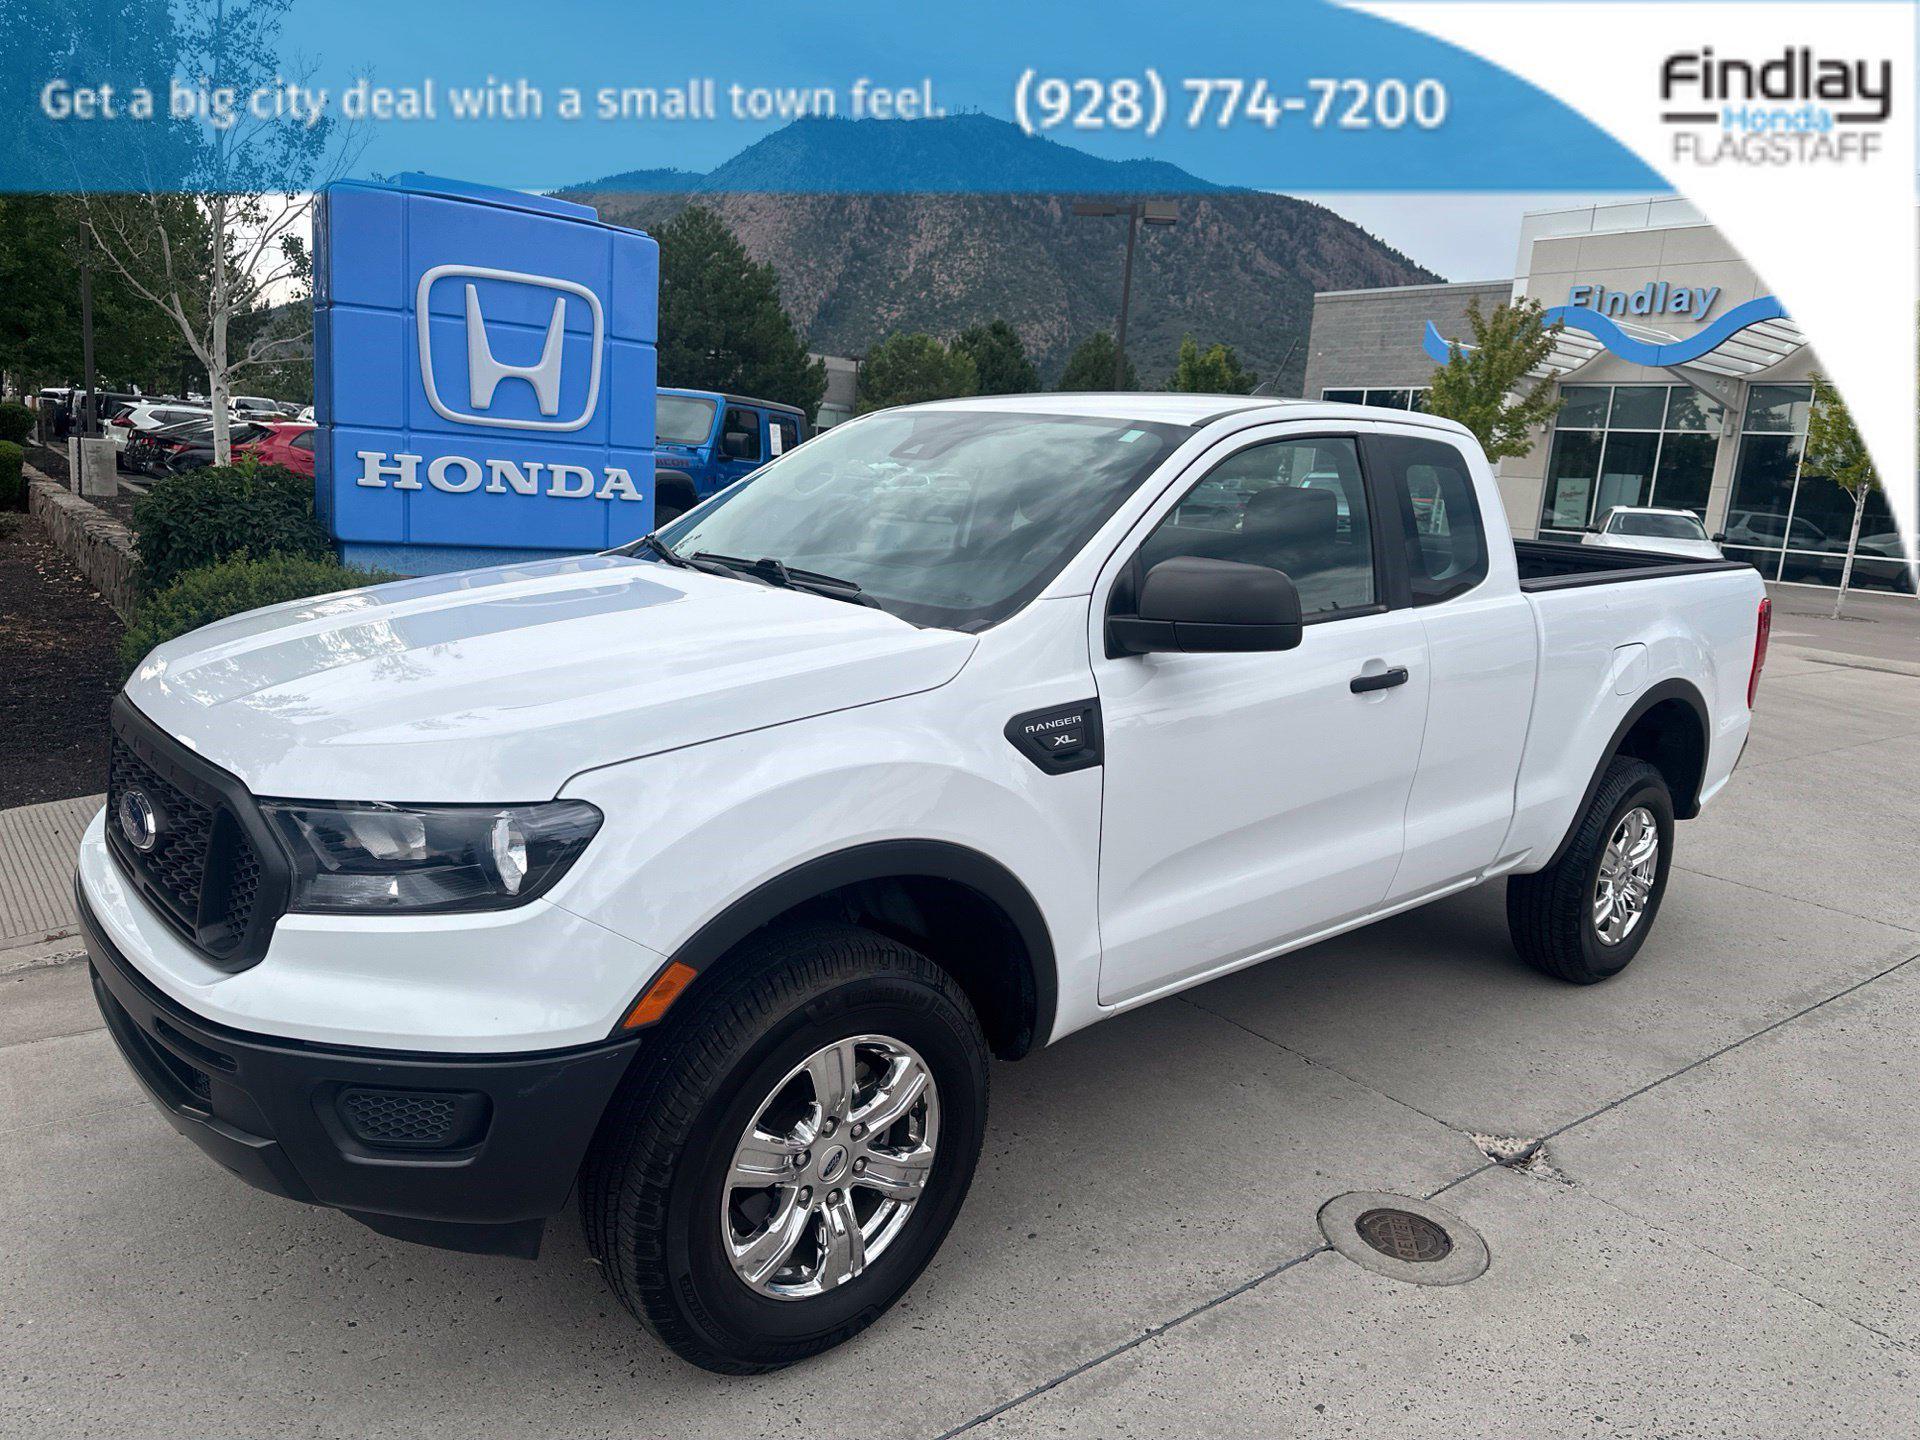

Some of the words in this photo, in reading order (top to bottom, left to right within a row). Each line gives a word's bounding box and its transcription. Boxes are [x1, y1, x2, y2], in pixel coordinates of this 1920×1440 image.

[1568, 280, 1722, 321] Findlay
[356, 450, 644, 502] HONDA
[1024, 715, 1082, 734] RANGER
[1053, 734, 1077, 747] XL
